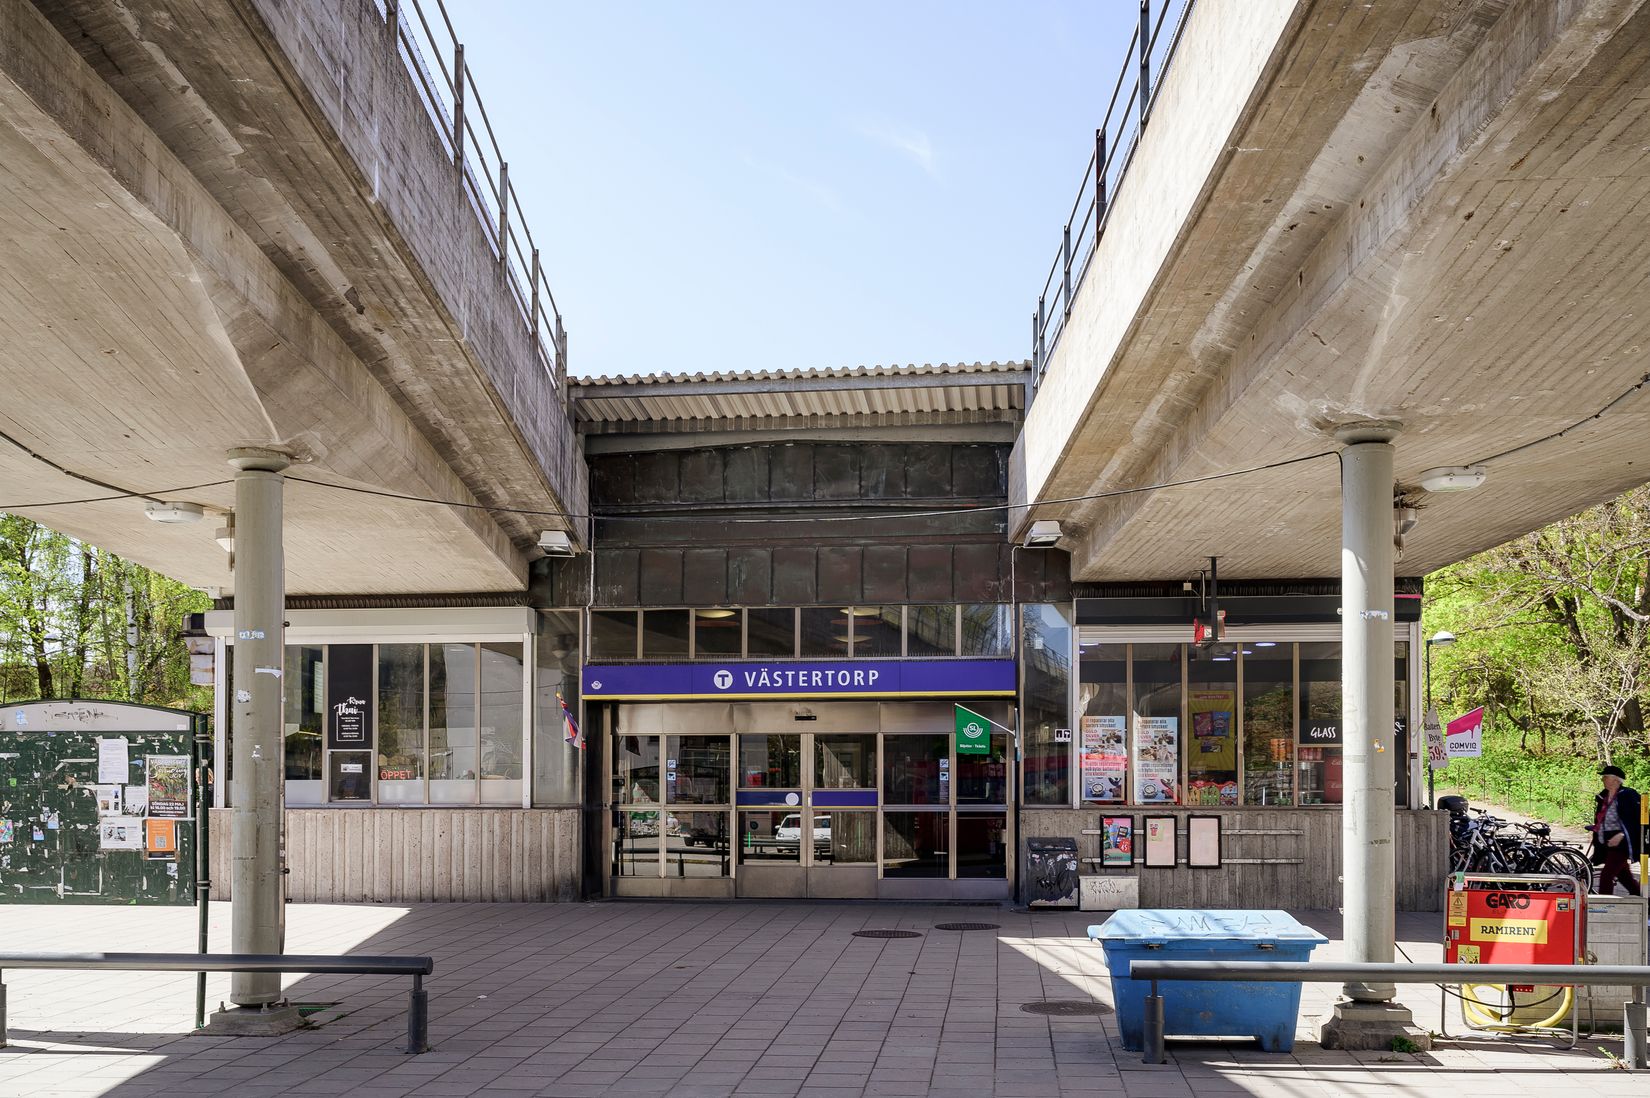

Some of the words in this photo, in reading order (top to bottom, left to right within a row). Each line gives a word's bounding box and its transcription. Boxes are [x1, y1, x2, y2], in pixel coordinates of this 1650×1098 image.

[744, 668, 880, 687] VÄSTERTORP
[334, 702, 358, 716] Thai
[1310, 726, 1336, 738] GLASS
[380, 768, 412, 780] ÖPPET
[1485, 893, 1530, 910] GARO
[1481, 925, 1536, 936] RAMIRENT
